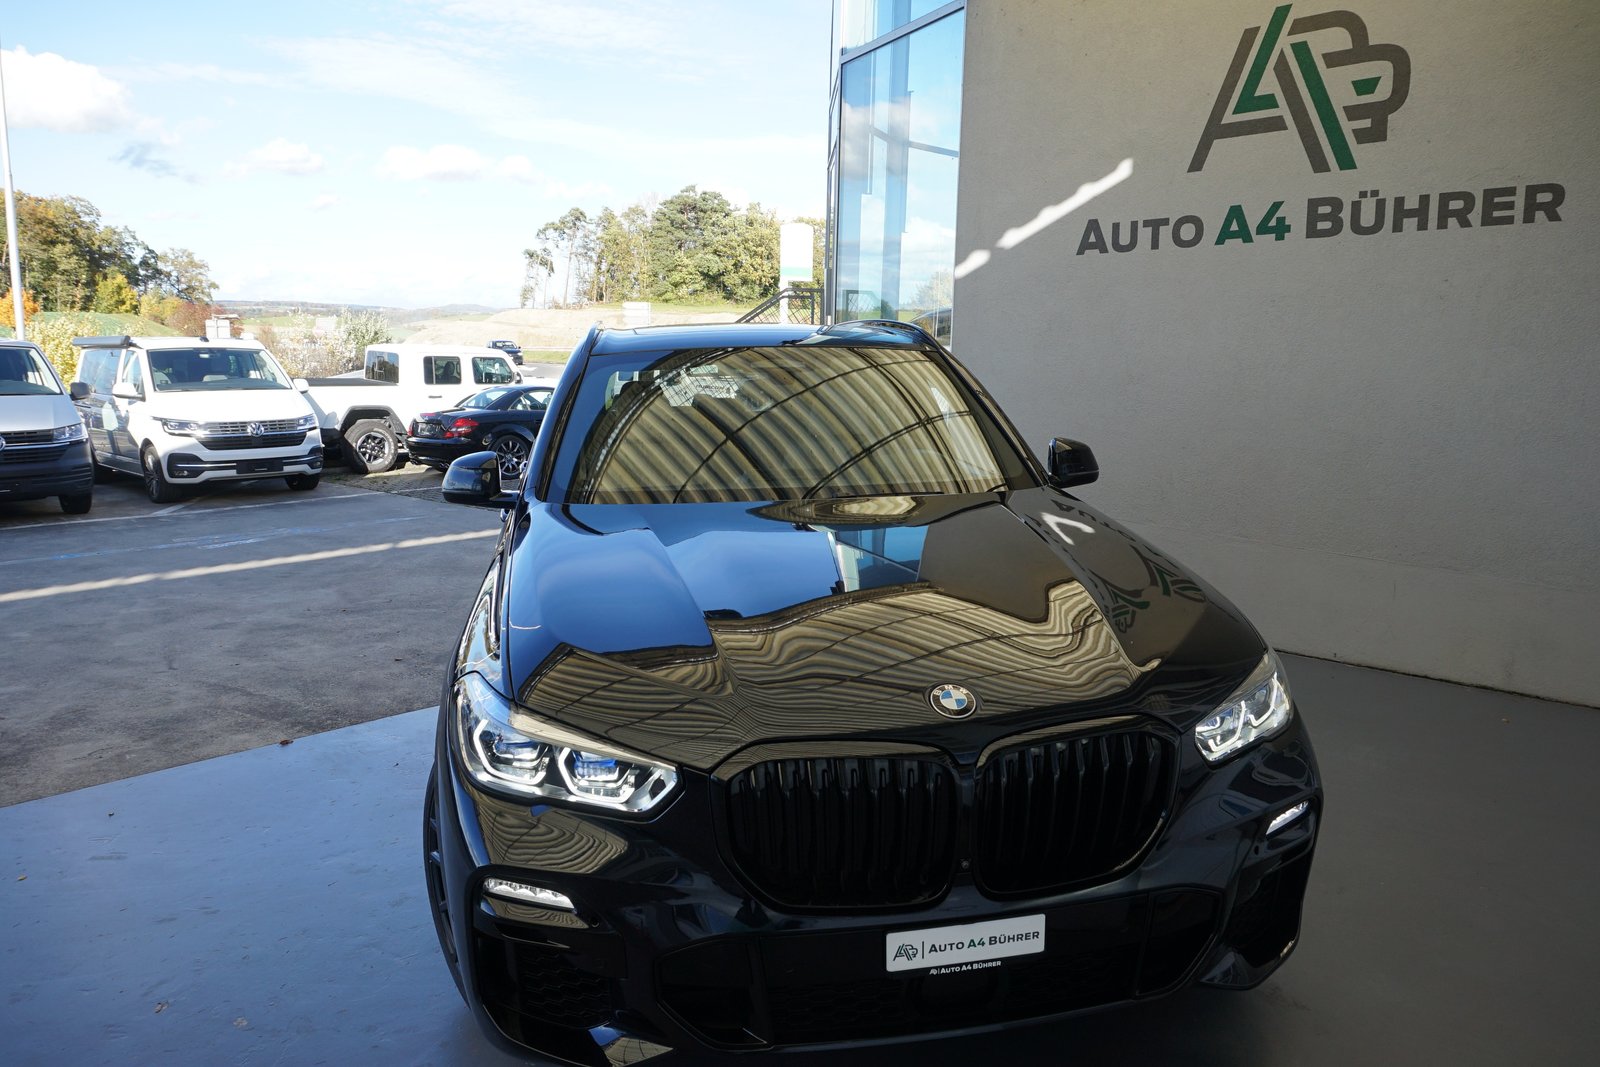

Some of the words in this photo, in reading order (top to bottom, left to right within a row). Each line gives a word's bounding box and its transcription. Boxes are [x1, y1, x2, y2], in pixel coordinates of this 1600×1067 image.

[1076, 215, 1204, 256] AUTO
[1214, 200, 1291, 245] A4
[1305, 183, 1566, 239] BÜHRER
[928, 941, 964, 954] AUTO
[967, 937, 986, 948] A4
[988, 931, 1040, 946] BÜHRER
[940, 966, 960, 974] AUTO
[961, 964, 971, 972] A4
[972, 960, 1001, 970] BÜHRER
